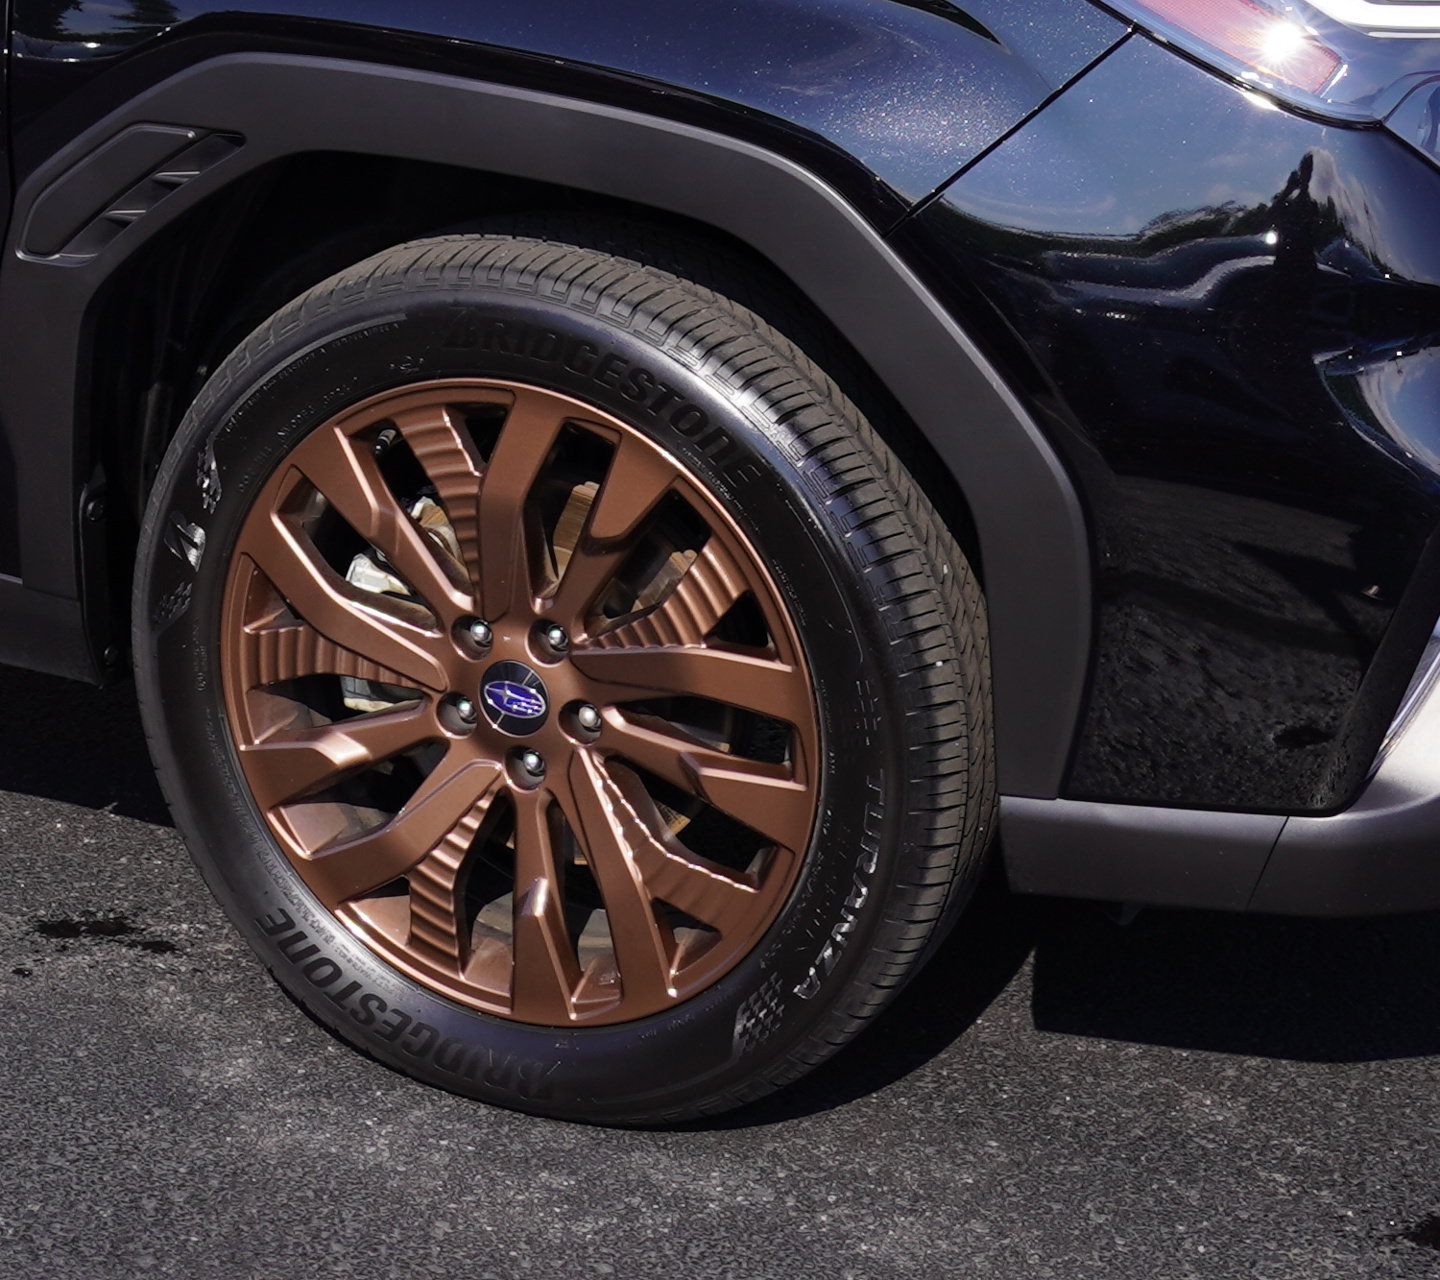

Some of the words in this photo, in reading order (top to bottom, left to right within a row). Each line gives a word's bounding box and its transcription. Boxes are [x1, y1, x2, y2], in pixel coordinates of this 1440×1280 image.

[440, 304, 762, 488] BRIDGESTONE
[793, 768, 886, 1000] TURANZA
[256, 906, 555, 1102] BRIDGESTONE
